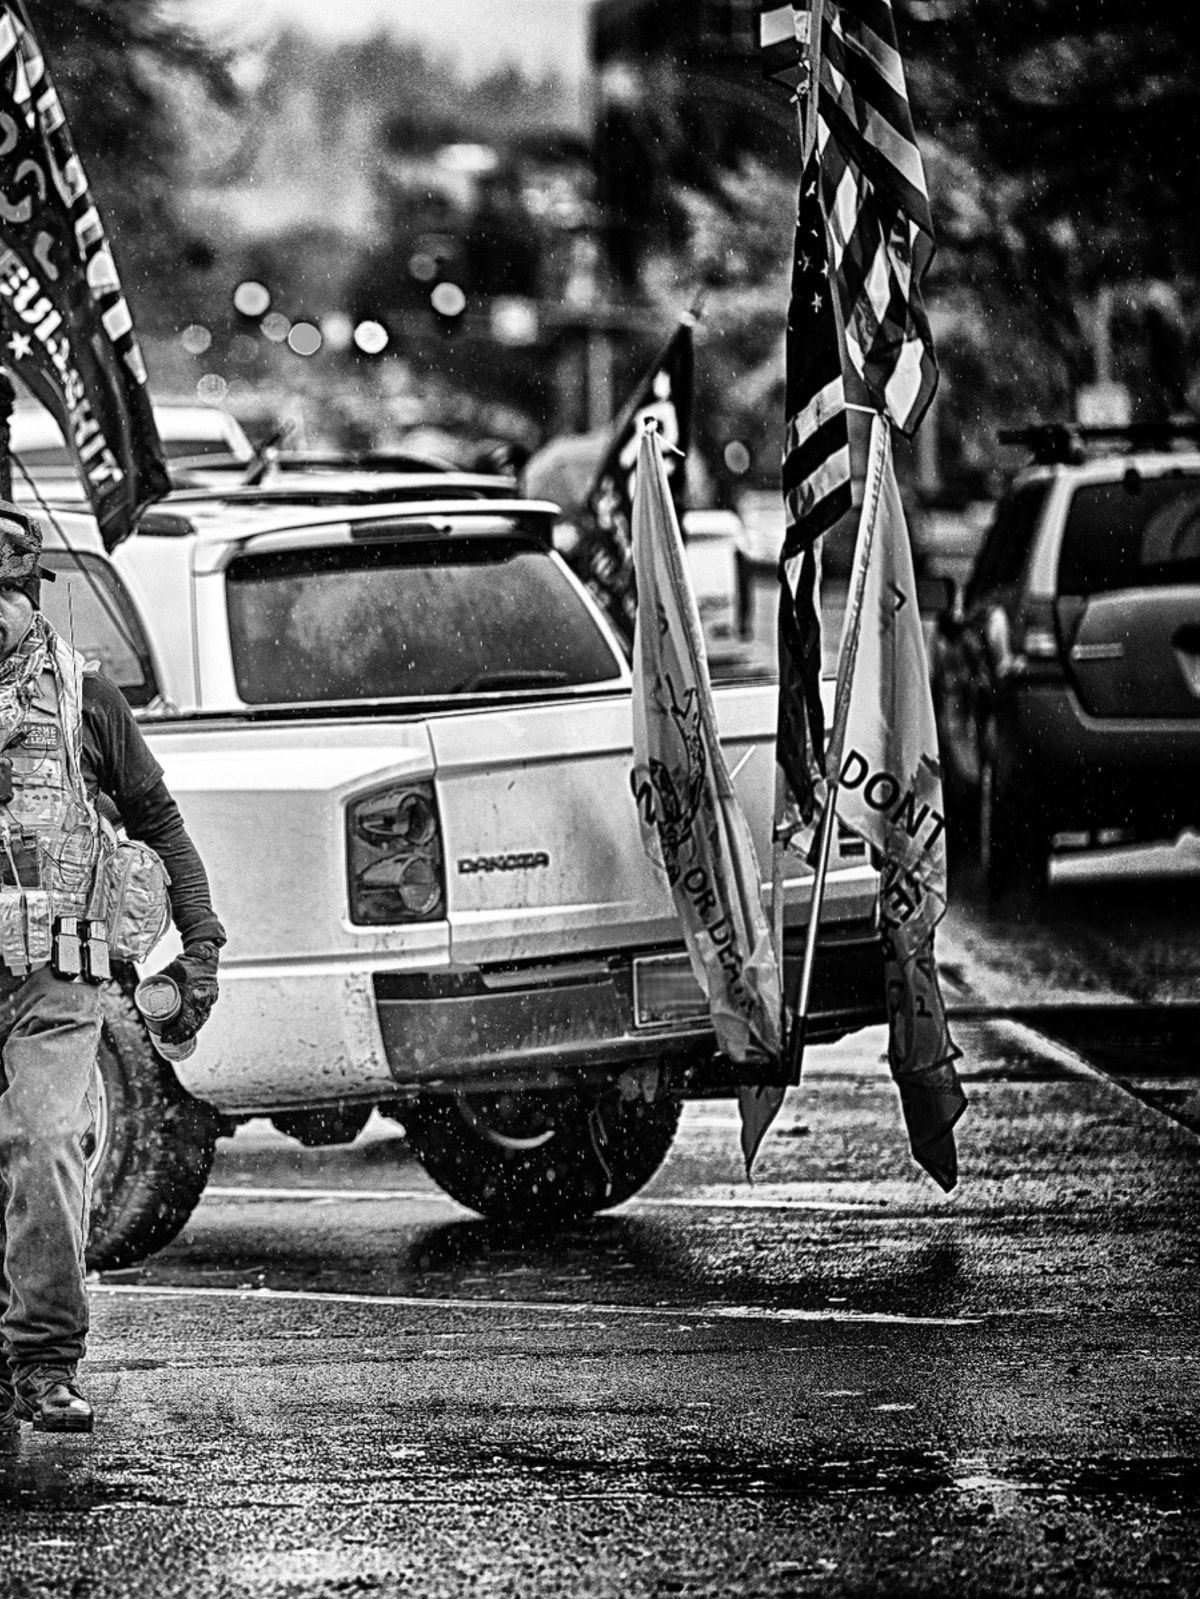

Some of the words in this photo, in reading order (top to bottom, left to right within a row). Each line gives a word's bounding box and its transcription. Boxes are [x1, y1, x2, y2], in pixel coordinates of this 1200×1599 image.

[838, 749, 946, 851] DONT
[457, 851, 550, 875] DAKOTA
[683, 867, 716, 923] OR
